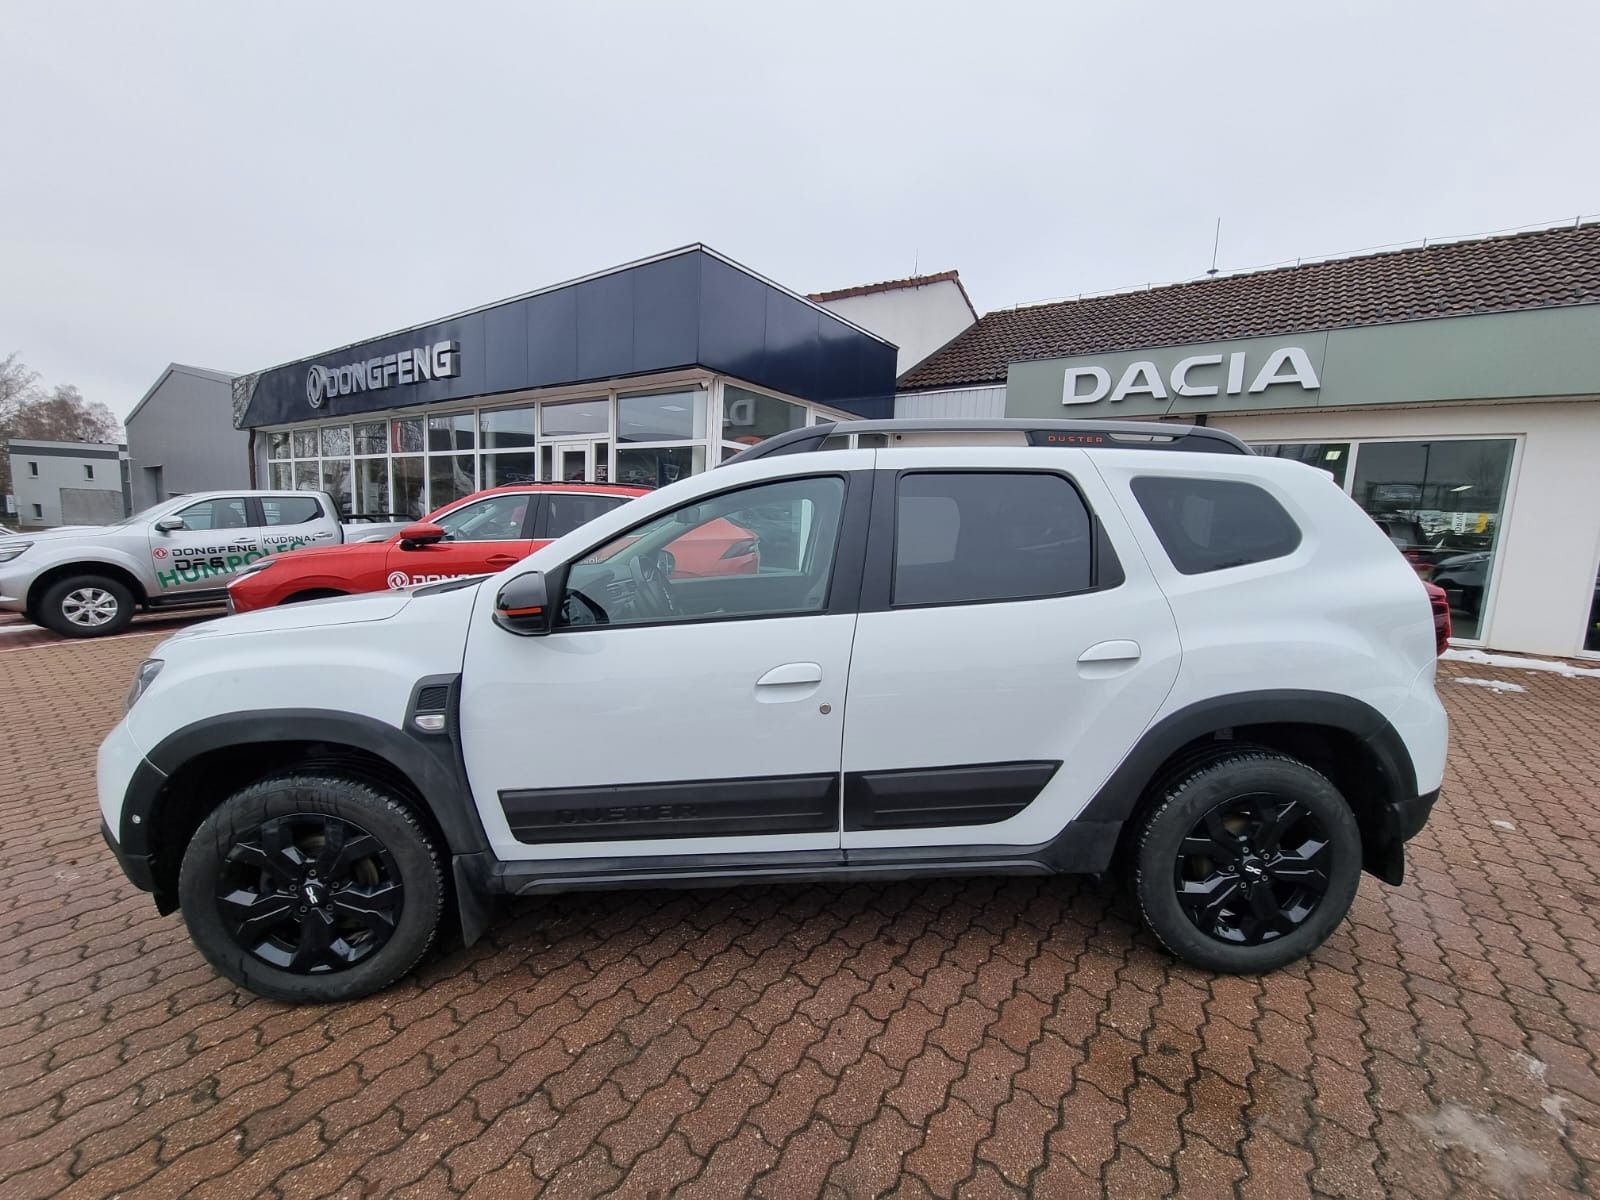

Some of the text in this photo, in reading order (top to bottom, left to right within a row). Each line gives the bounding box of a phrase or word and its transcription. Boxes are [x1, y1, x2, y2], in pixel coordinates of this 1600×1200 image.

[326, 340, 459, 398] DONGFENG
[1062, 347, 1320, 405] DACIA
[1048, 435, 1103, 443] DUSTER
[172, 544, 257, 557] DONGFENG
[175, 556, 224, 571] DF6
